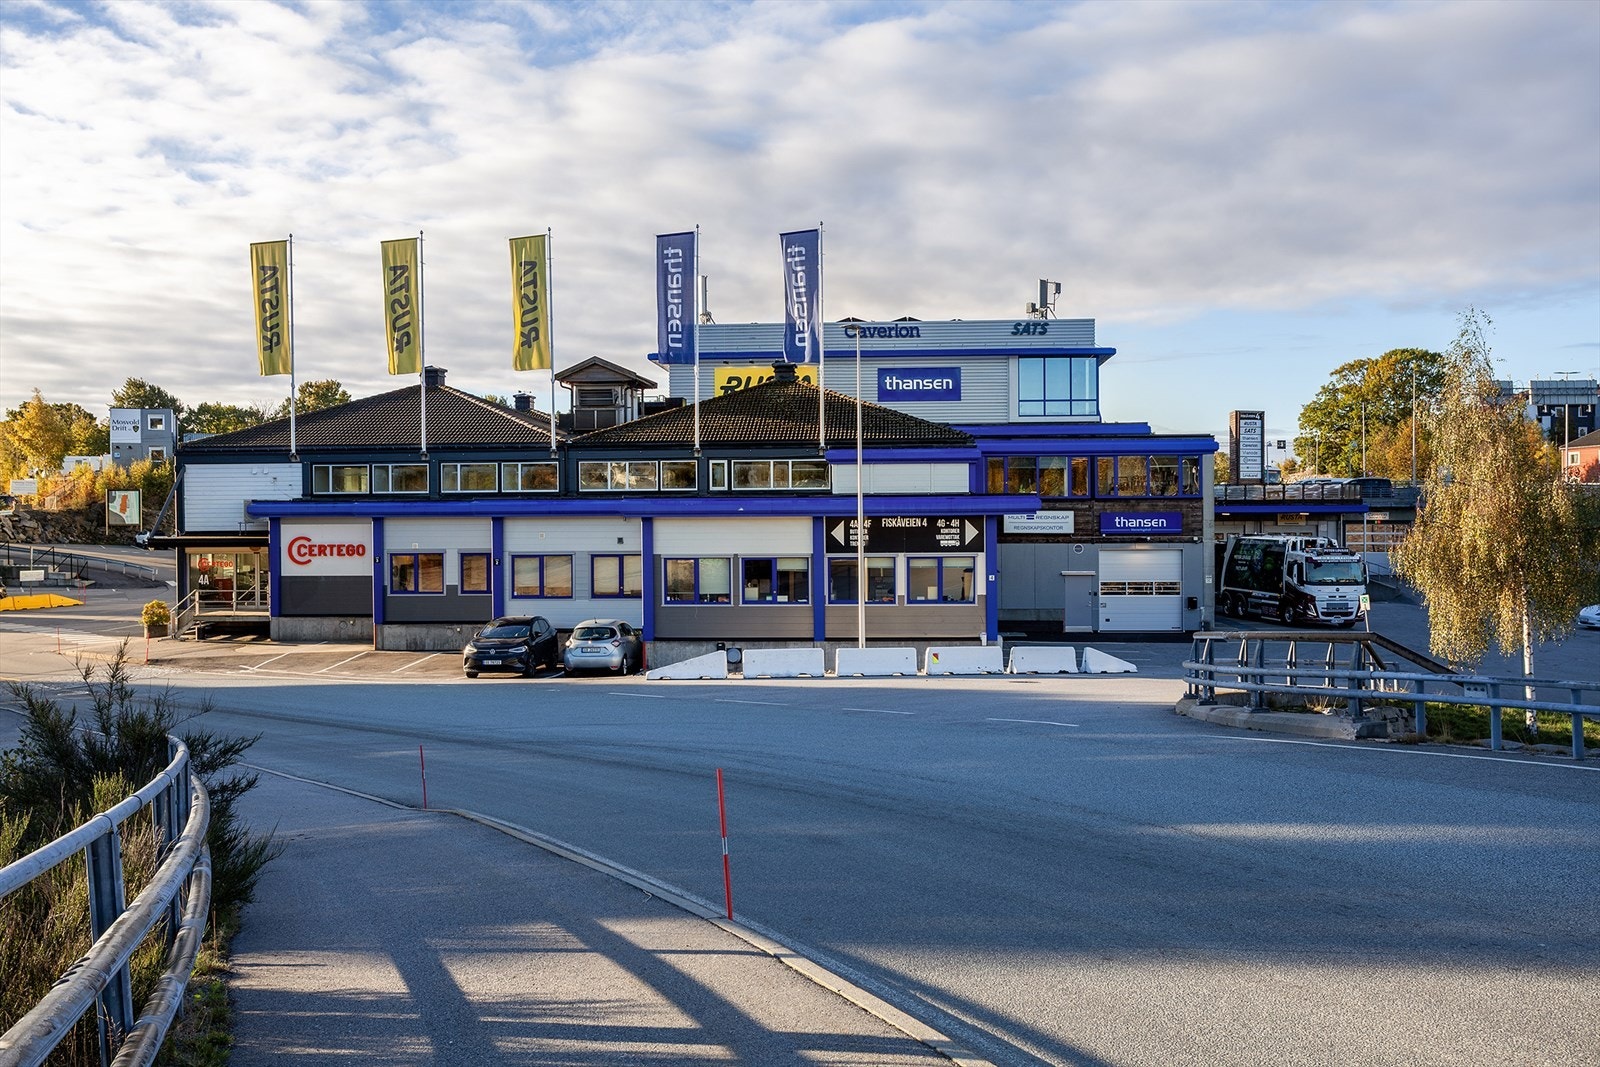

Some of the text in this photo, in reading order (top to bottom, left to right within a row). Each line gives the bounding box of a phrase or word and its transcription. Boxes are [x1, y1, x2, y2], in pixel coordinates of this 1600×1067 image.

[1010, 322, 1050, 336] SATS
[884, 375, 953, 390] thansen
[863, 519, 872, 528] 4F
[881, 516, 928, 528] FISKÅVEIEN 4
[936, 519, 946, 527] 4G
[950, 519, 960, 527] 4H
[1114, 516, 1167, 528] thansen
[198, 574, 210, 585] 4A
